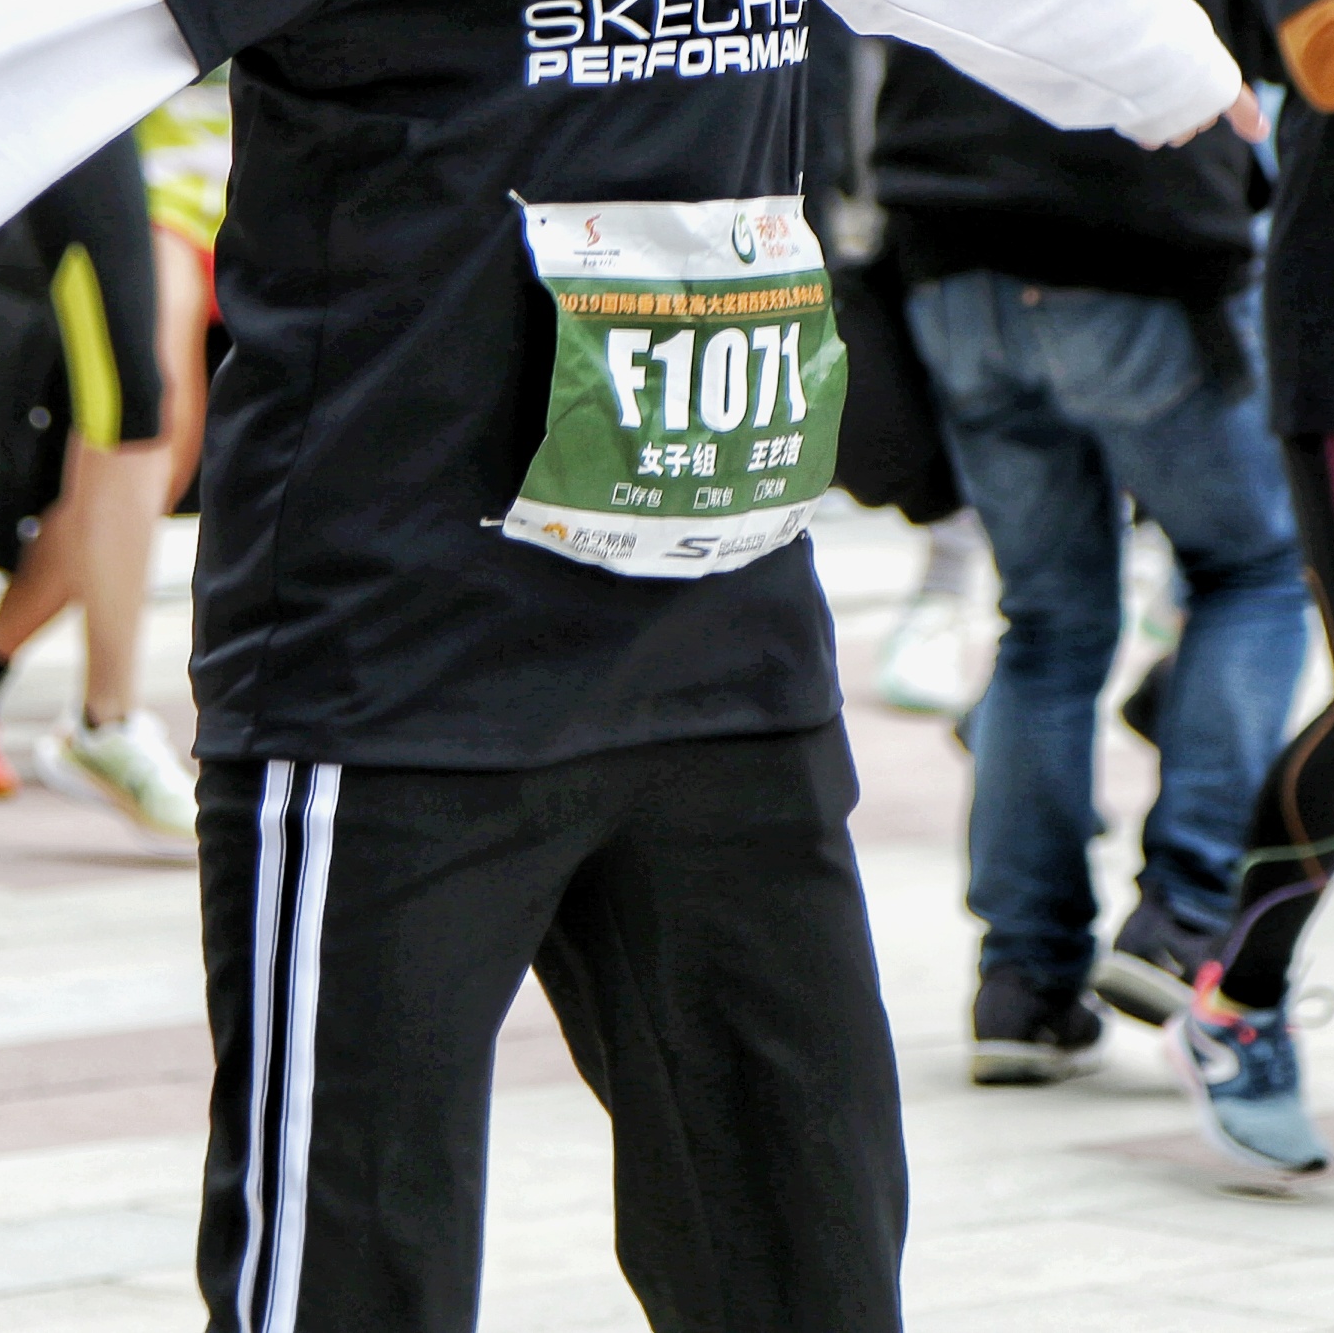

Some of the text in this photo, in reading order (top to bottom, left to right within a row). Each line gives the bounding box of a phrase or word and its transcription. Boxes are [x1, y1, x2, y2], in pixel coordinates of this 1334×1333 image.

[607, 321, 808, 432] F1071
[637, 441, 718, 478] 女子组
[630, 485, 664, 508] 存包
